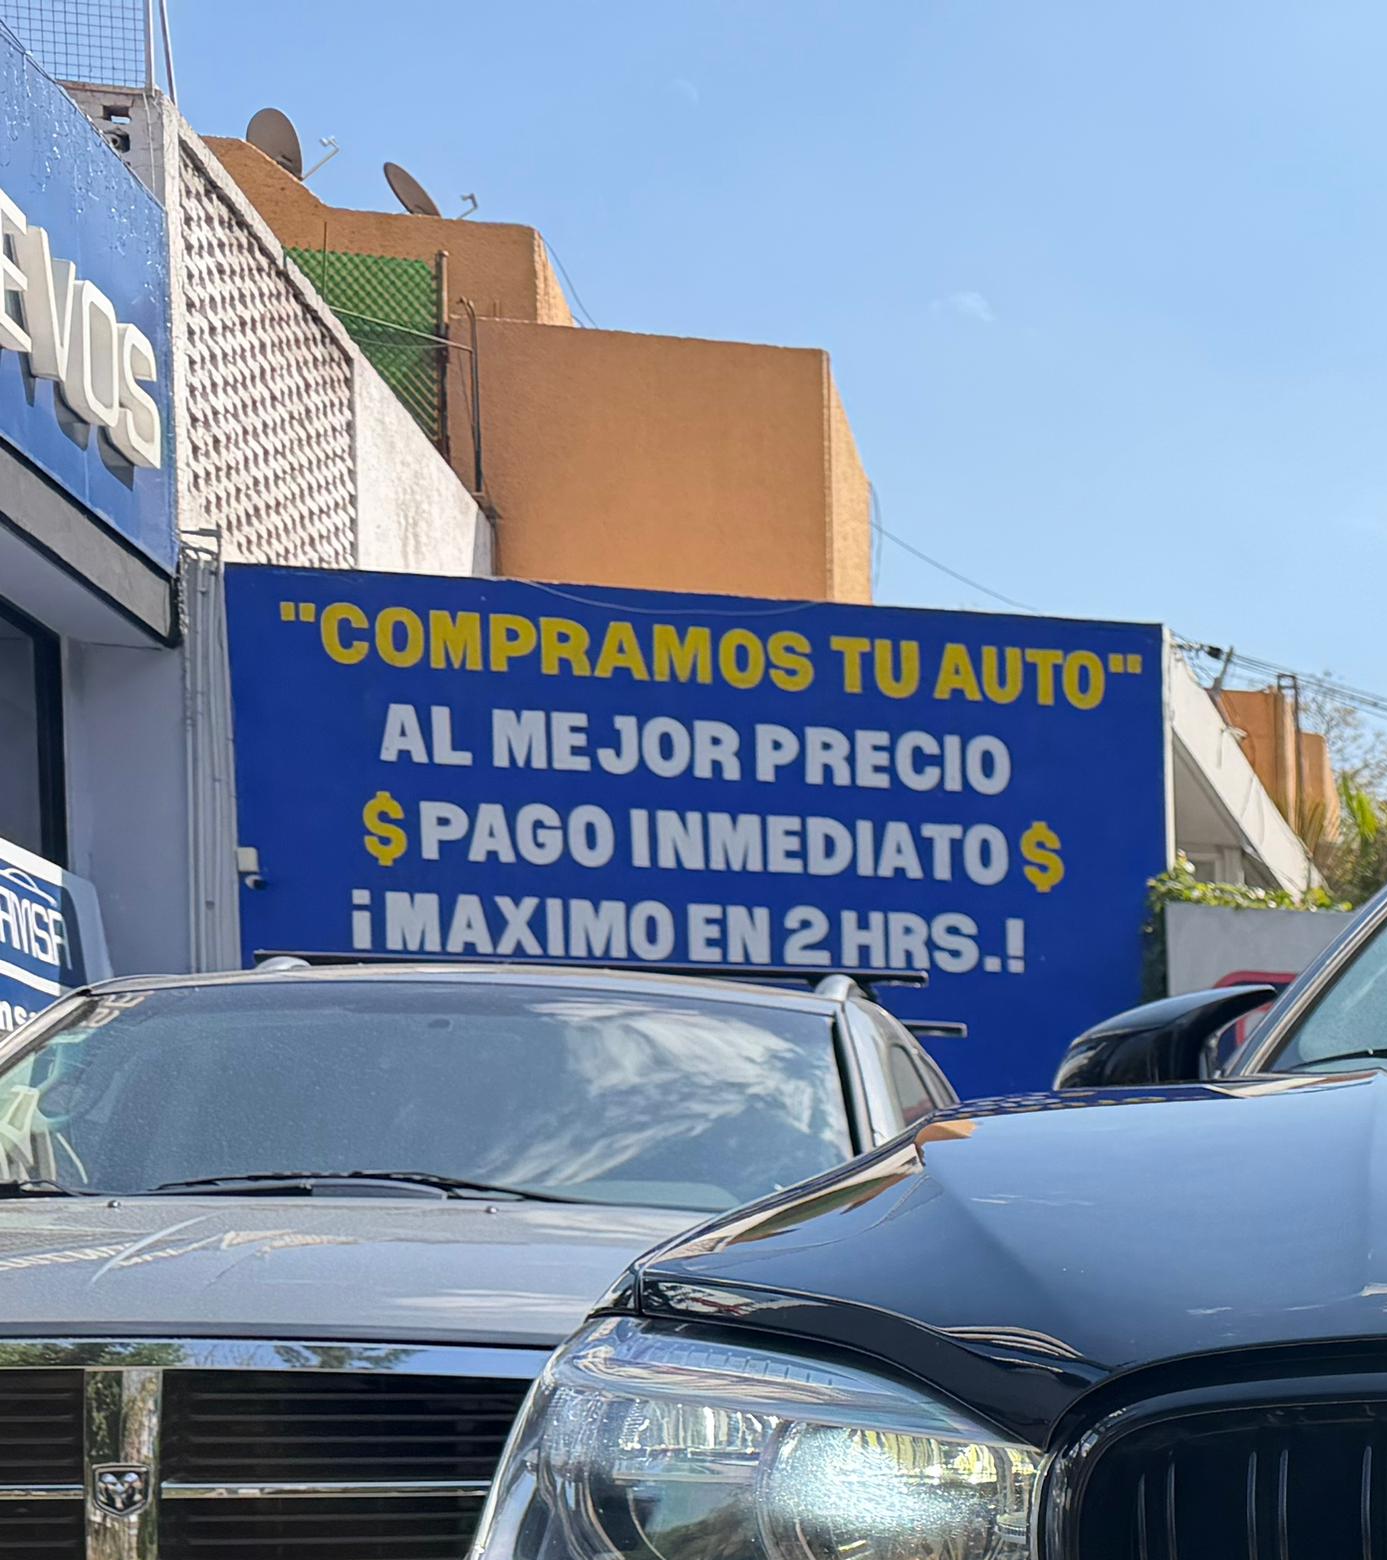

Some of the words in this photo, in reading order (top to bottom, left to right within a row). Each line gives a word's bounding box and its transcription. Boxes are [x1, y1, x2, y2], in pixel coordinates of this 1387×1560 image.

[279, 601, 815, 692] "COMPRAMOS
[830, 635, 920, 699] TU
[933, 643, 1142, 710] AUTO"
[380, 703, 473, 766] AL
[492, 708, 741, 781] MEJOR
[755, 724, 1011, 795] PRECIO
[419, 800, 615, 868] PAGO
[630, 808, 1009, 885] INMEDIATO
[352, 889, 675, 961] ¡MAXIMO
[687, 903, 771, 964] EN
[784, 905, 832, 966] 2
[841, 910, 1025, 973] HRS.!
